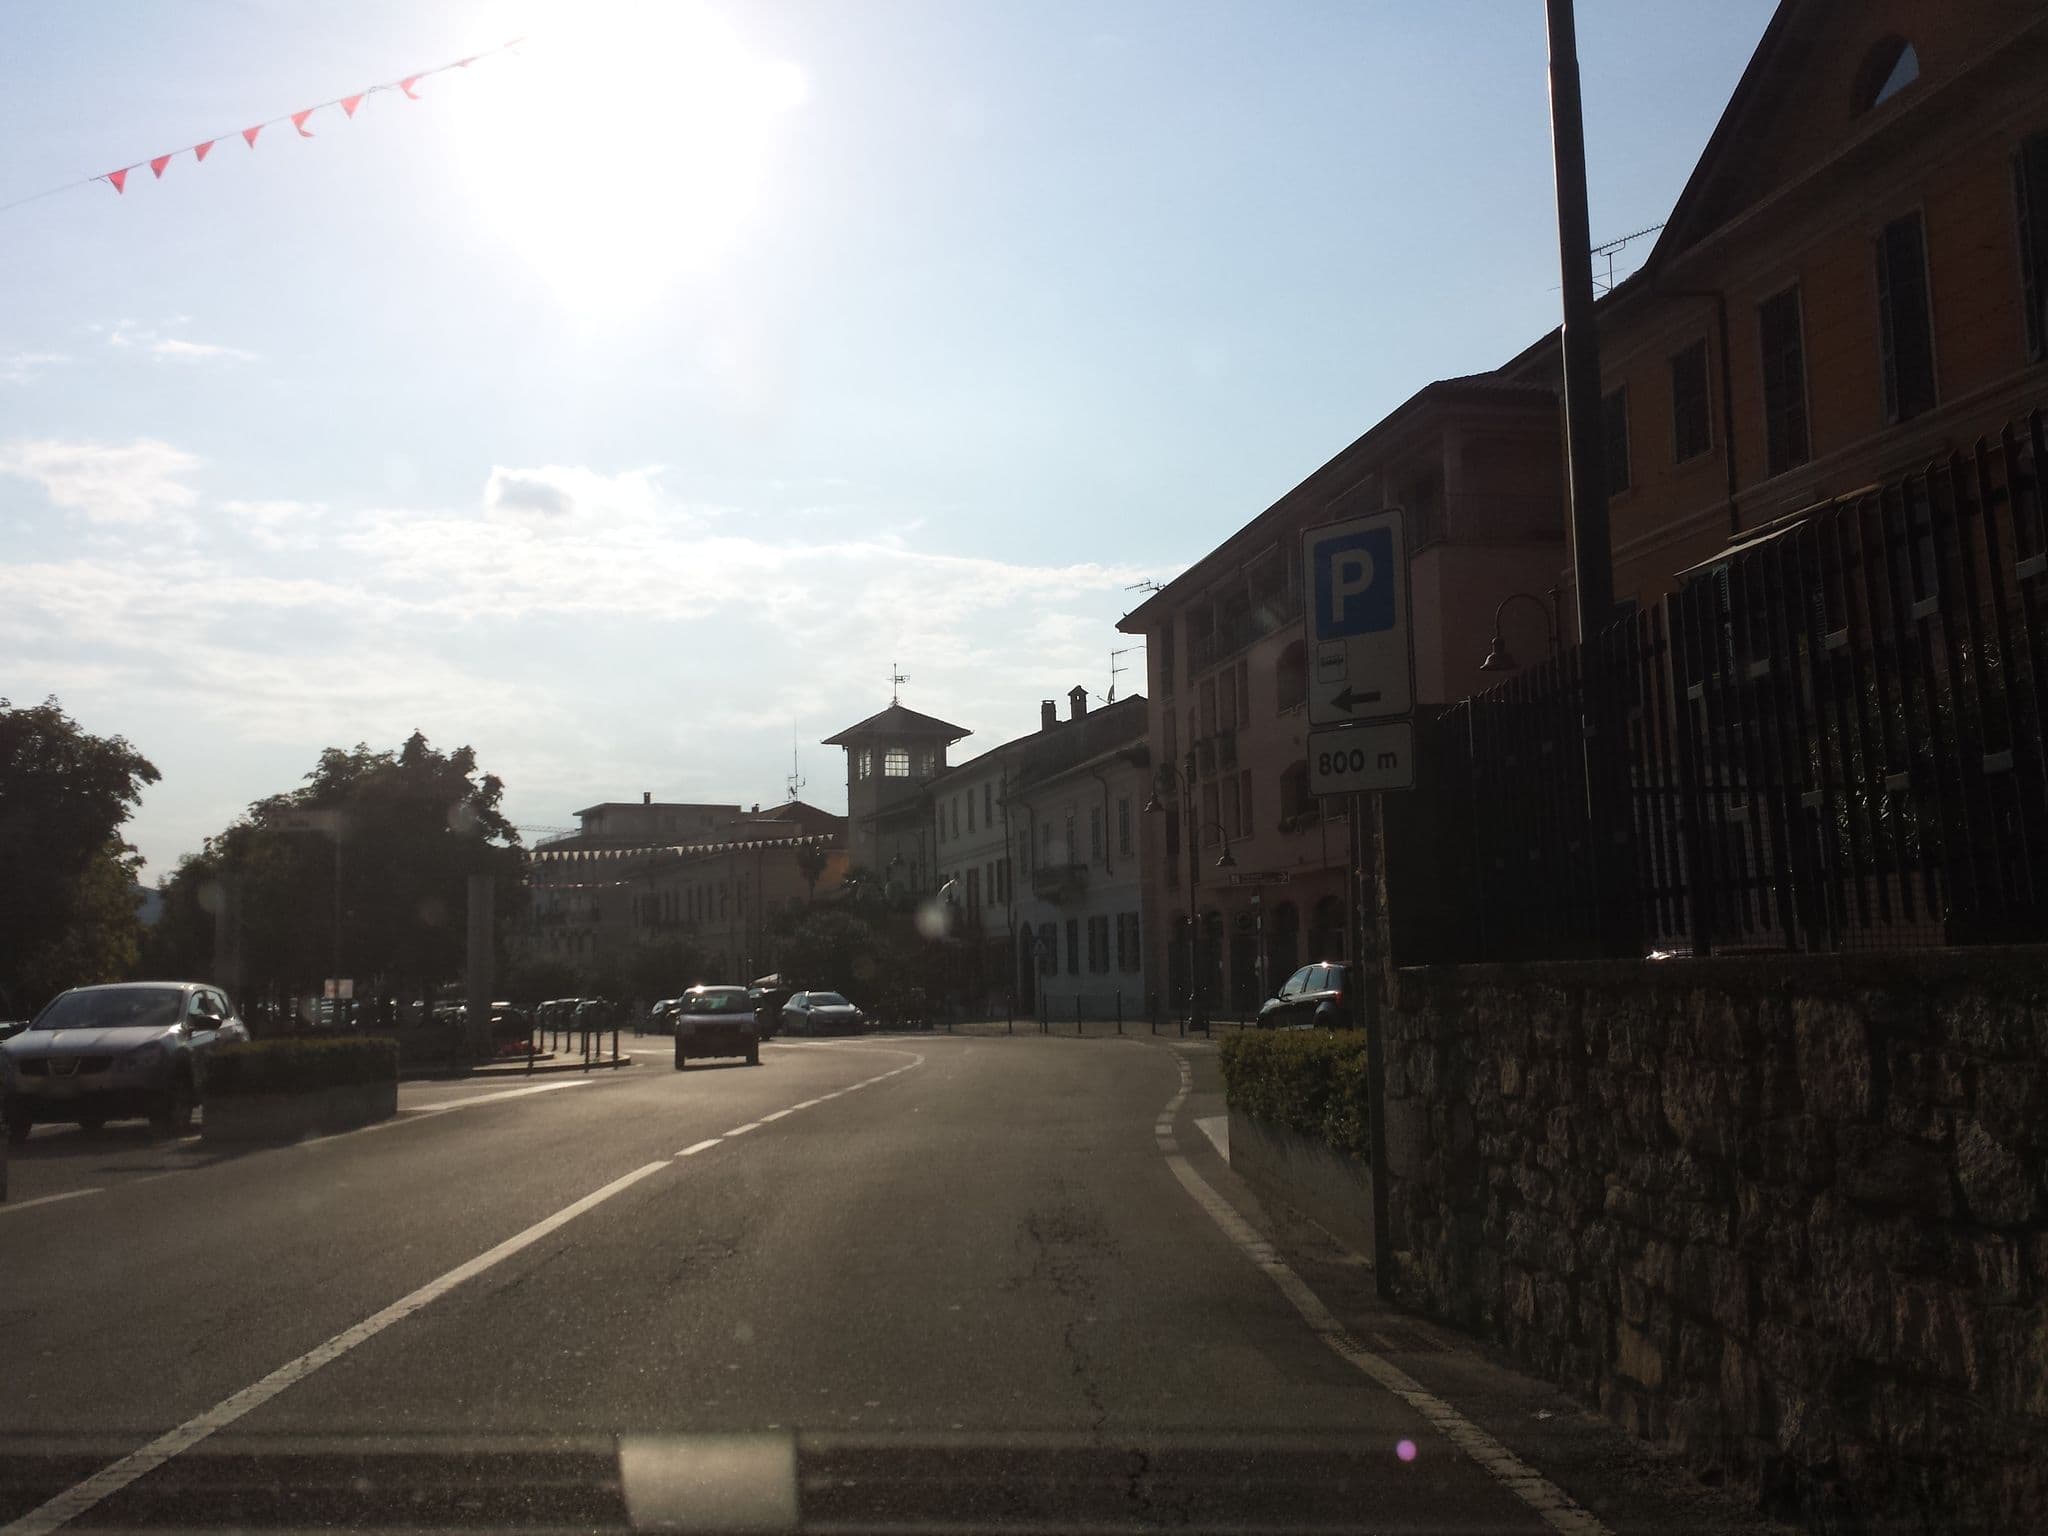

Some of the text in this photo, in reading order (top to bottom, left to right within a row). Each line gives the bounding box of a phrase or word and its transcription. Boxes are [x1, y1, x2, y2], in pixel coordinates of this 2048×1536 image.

[1331, 549, 1374, 623] P
[1319, 749, 1397, 777] 800 m
